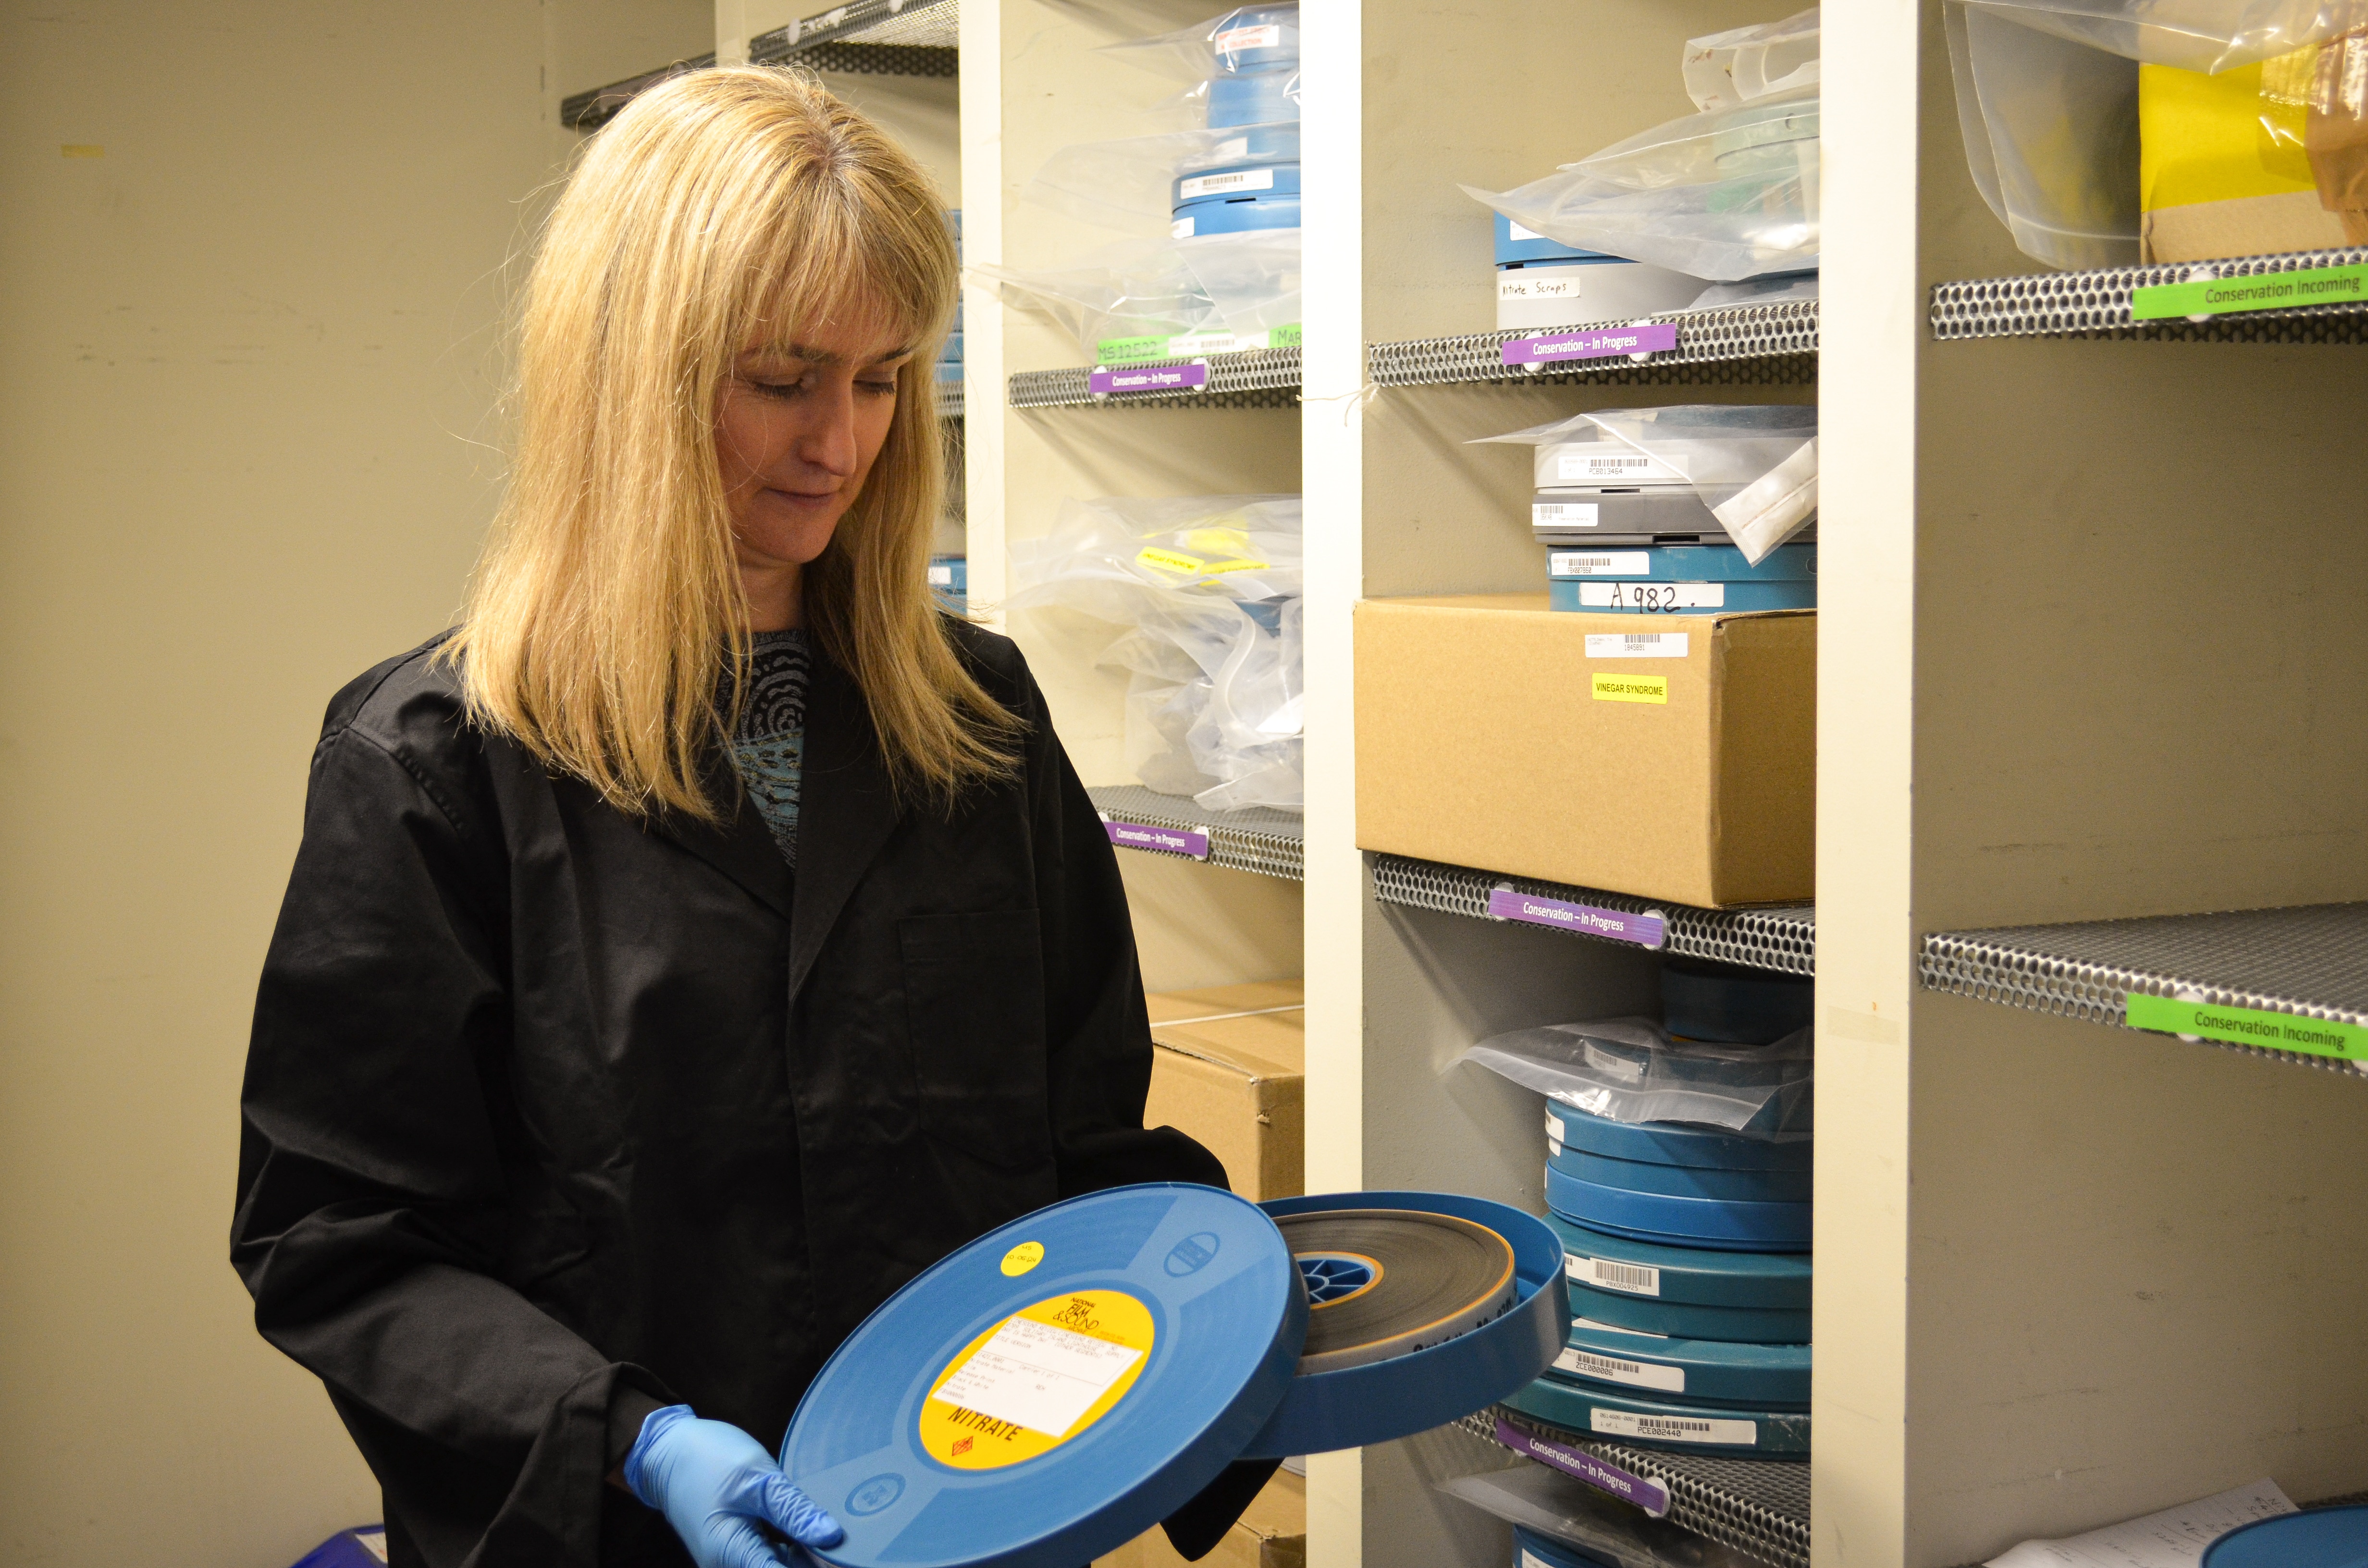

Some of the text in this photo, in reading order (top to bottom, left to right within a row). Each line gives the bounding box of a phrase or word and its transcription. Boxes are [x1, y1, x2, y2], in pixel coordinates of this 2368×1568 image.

[1503, 282, 1566, 296] Nitrate Scraps
[2205, 275, 2360, 304] Conservation Incoming
[1533, 339, 1583, 355] Conservation
[1592, 337, 1601, 350] In
[1603, 335, 1637, 351] Progress
[1112, 374, 1147, 386] Conservation
[1152, 374, 1158, 383] In
[1159, 372, 1181, 385] Progress
[1611, 583, 1623, 611] A
[1596, 683, 1663, 695] VINEGAR SYNDROME
[1116, 828, 1151, 842] Conservation
[1156, 833, 1161, 844] In
[1162, 834, 1185, 847] Progress
[1523, 902, 1573, 922] Conservation
[1581, 912, 1589, 925] In
[1591, 914, 1624, 931] Progress
[2195, 1011, 2345, 1051] Conservation Incoming
[1606, 1281, 1639, 1291] PBX004925
[1071, 1297, 1096, 1308] NATIONAL
[1066, 1303, 1091, 1317] FILM
[1009, 1339, 1033, 1348] VERSION
[1017, 1364, 1041, 1374] Carrier
[1576, 1362, 1613, 1376] ZCE000006
[979, 1375, 997, 1383] Print
[948, 1406, 1024, 1441] NITRATE
[1638, 1427, 1681, 1437] PCE002440
[1530, 1438, 1580, 1470] Conservation
[1589, 1463, 1596, 1477] In
[1598, 1466, 1631, 1494] Progress
